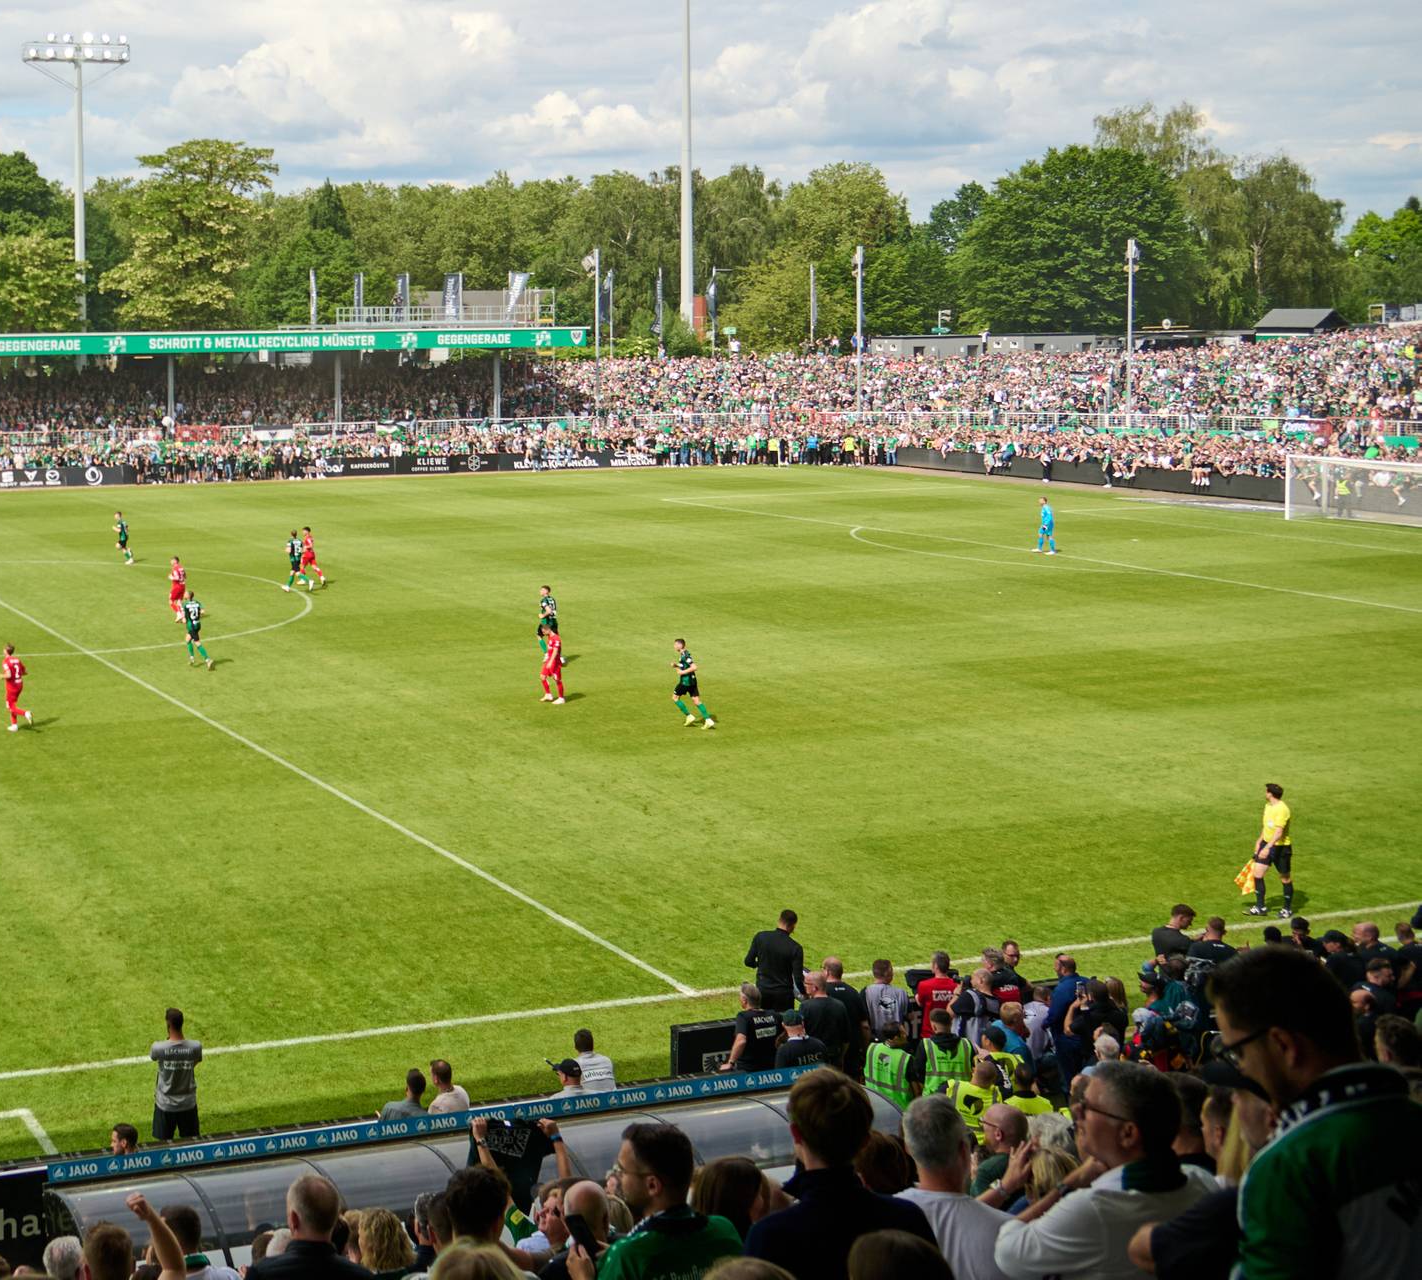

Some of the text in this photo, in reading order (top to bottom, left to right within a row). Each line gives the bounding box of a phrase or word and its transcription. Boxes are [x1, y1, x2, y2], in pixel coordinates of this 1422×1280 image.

[149, 332, 375, 350] SCHROTT & METALLRECYCLING MÜNSTER
[437, 333, 511, 345] GEGENGERADE
[713, 1078, 739, 1091] JAKO
[758, 1072, 783, 1085] JAKO
[621, 1091, 647, 1104] JAKO
[667, 1085, 693, 1097] JAKO
[528, 1103, 553, 1116] JAKO
[575, 1097, 600, 1110] JAKO
[381, 1122, 408, 1136] JAKO
[430, 1116, 457, 1130] JAKO
[279, 1136, 307, 1149] JAKO
[330, 1129, 358, 1143] JAKO
[228, 1142, 256, 1156] JAKO
[122, 1156, 151, 1170] JAKO
[175, 1150, 204, 1164] JAKO
[68, 1163, 98, 1177] JAKO
